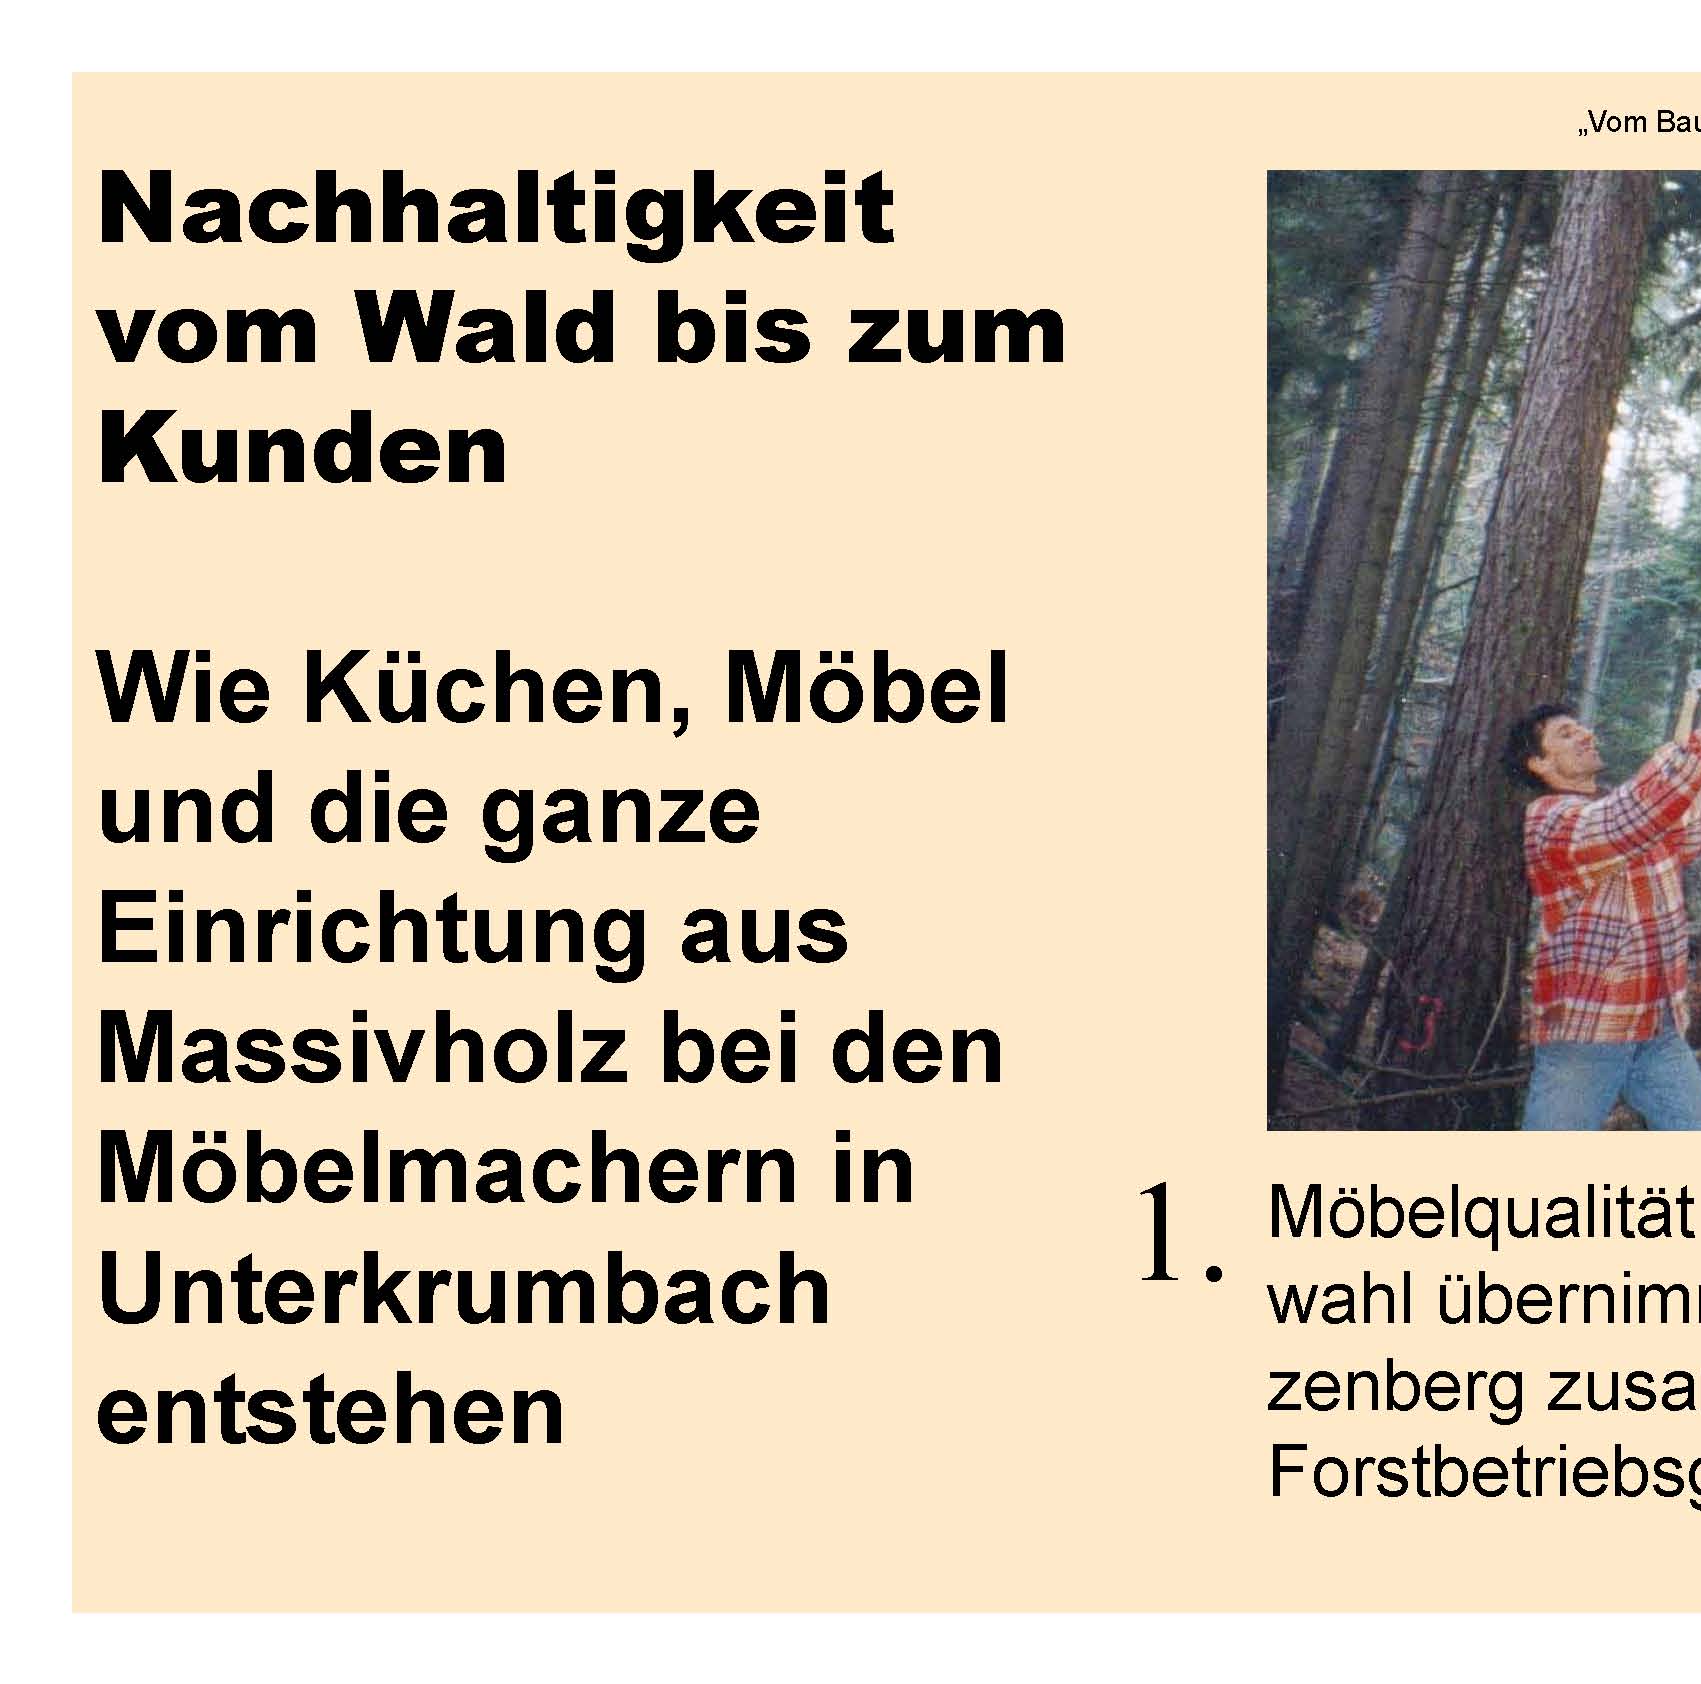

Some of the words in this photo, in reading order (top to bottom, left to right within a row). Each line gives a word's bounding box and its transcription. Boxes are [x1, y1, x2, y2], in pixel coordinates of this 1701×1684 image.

[102, 170, 894, 263] Nachhaltigkeit
[95, 309, 315, 363] vom
[354, 290, 613, 363] Wald
[658, 290, 810, 363] bis
[849, 309, 1063, 363] zum
[102, 410, 504, 483] Kunden
[95, 650, 269, 723] Wie
[307, 650, 688, 738] Küchen,
[729, 650, 1005, 723] Möbel
[102, 770, 272, 843] und
[311, 770, 447, 843] die
[483, 789, 759, 863] ganze
[102, 890, 644, 983] Einrichtung
[682, 909, 847, 963] aus
[101, 1010, 627, 1083] Massivholz
[664, 1010, 795, 1083] bei
[833, 1010, 1000, 1083] den
[101, 1130, 794, 1203] Möbelmachern
[836, 1130, 911, 1202] in
[1140, 1182, 1222, 1282] 1.
[1272, 1184, 1695, 1251] Möbelqualität
[102, 1251, 827, 1324] Unterkrumbach
[1267, 1271, 1410, 1324] wahl
[98, 1371, 561, 1444] entstehen
[1268, 1358, 1522, 1425] zenberg
